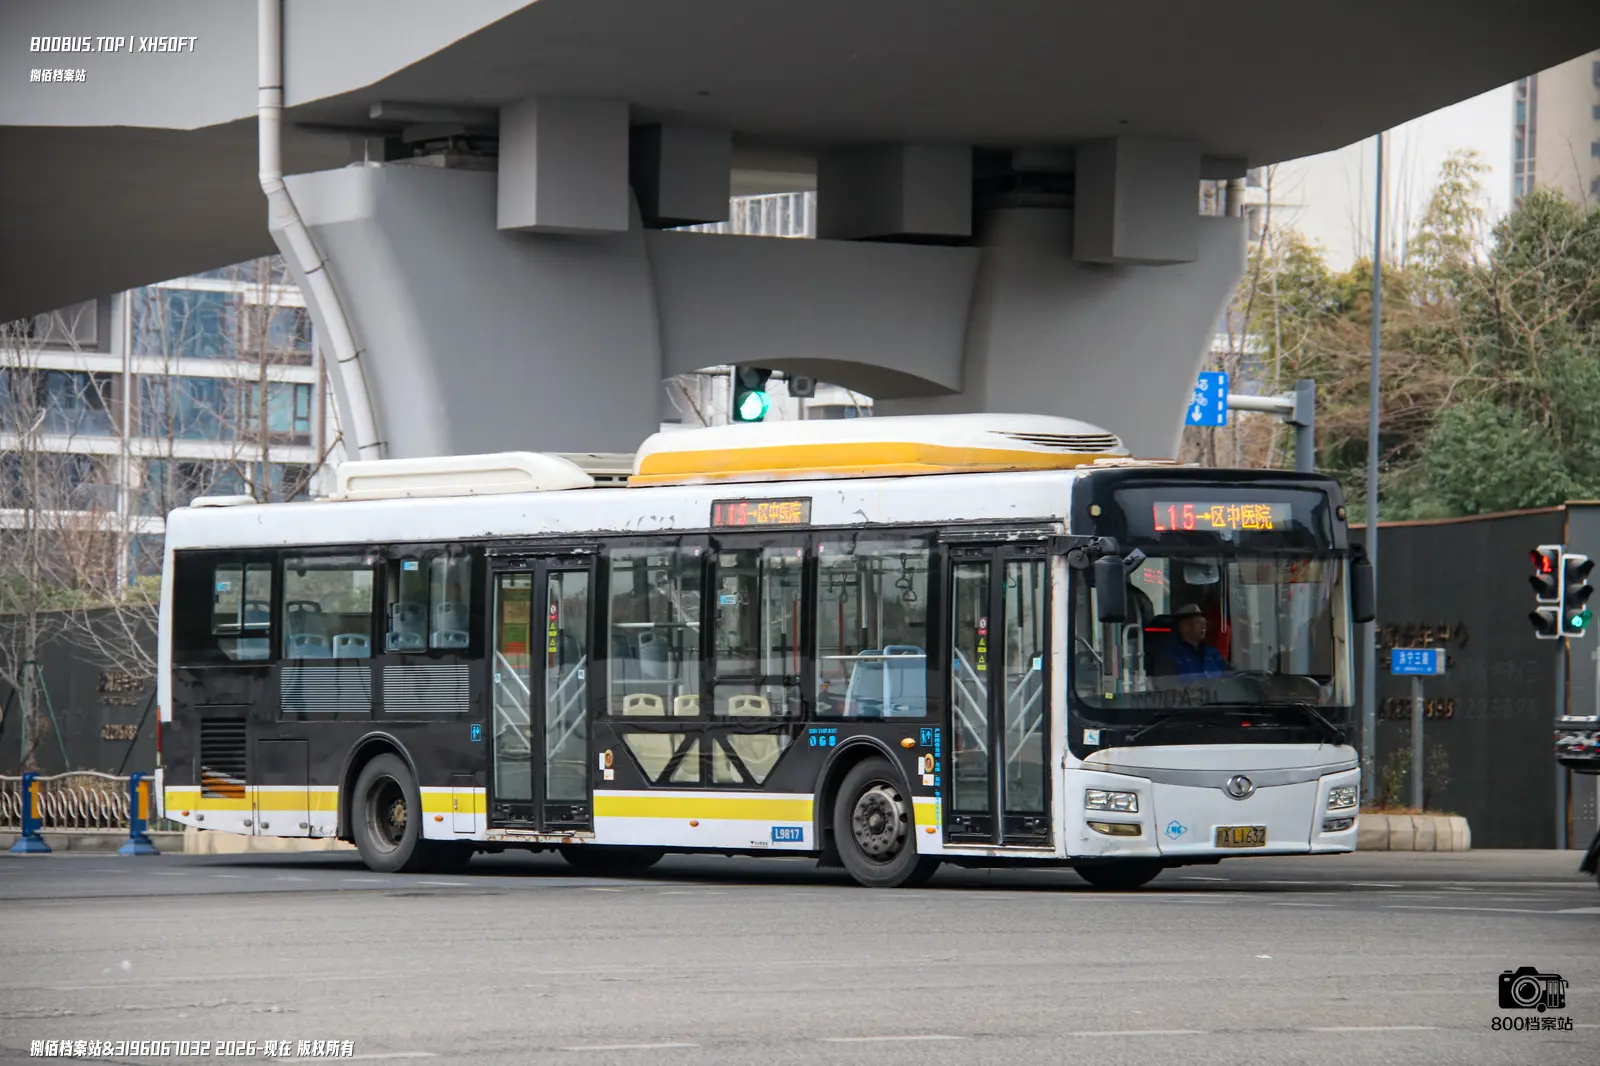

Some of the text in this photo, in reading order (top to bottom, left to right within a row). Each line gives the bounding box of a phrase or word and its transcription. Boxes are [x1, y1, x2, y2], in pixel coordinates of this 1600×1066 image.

[714, 501, 803, 527] L15 区中医院
[1153, 503, 1273, 531] L15 区中医院
[775, 828, 800, 840] L9817
